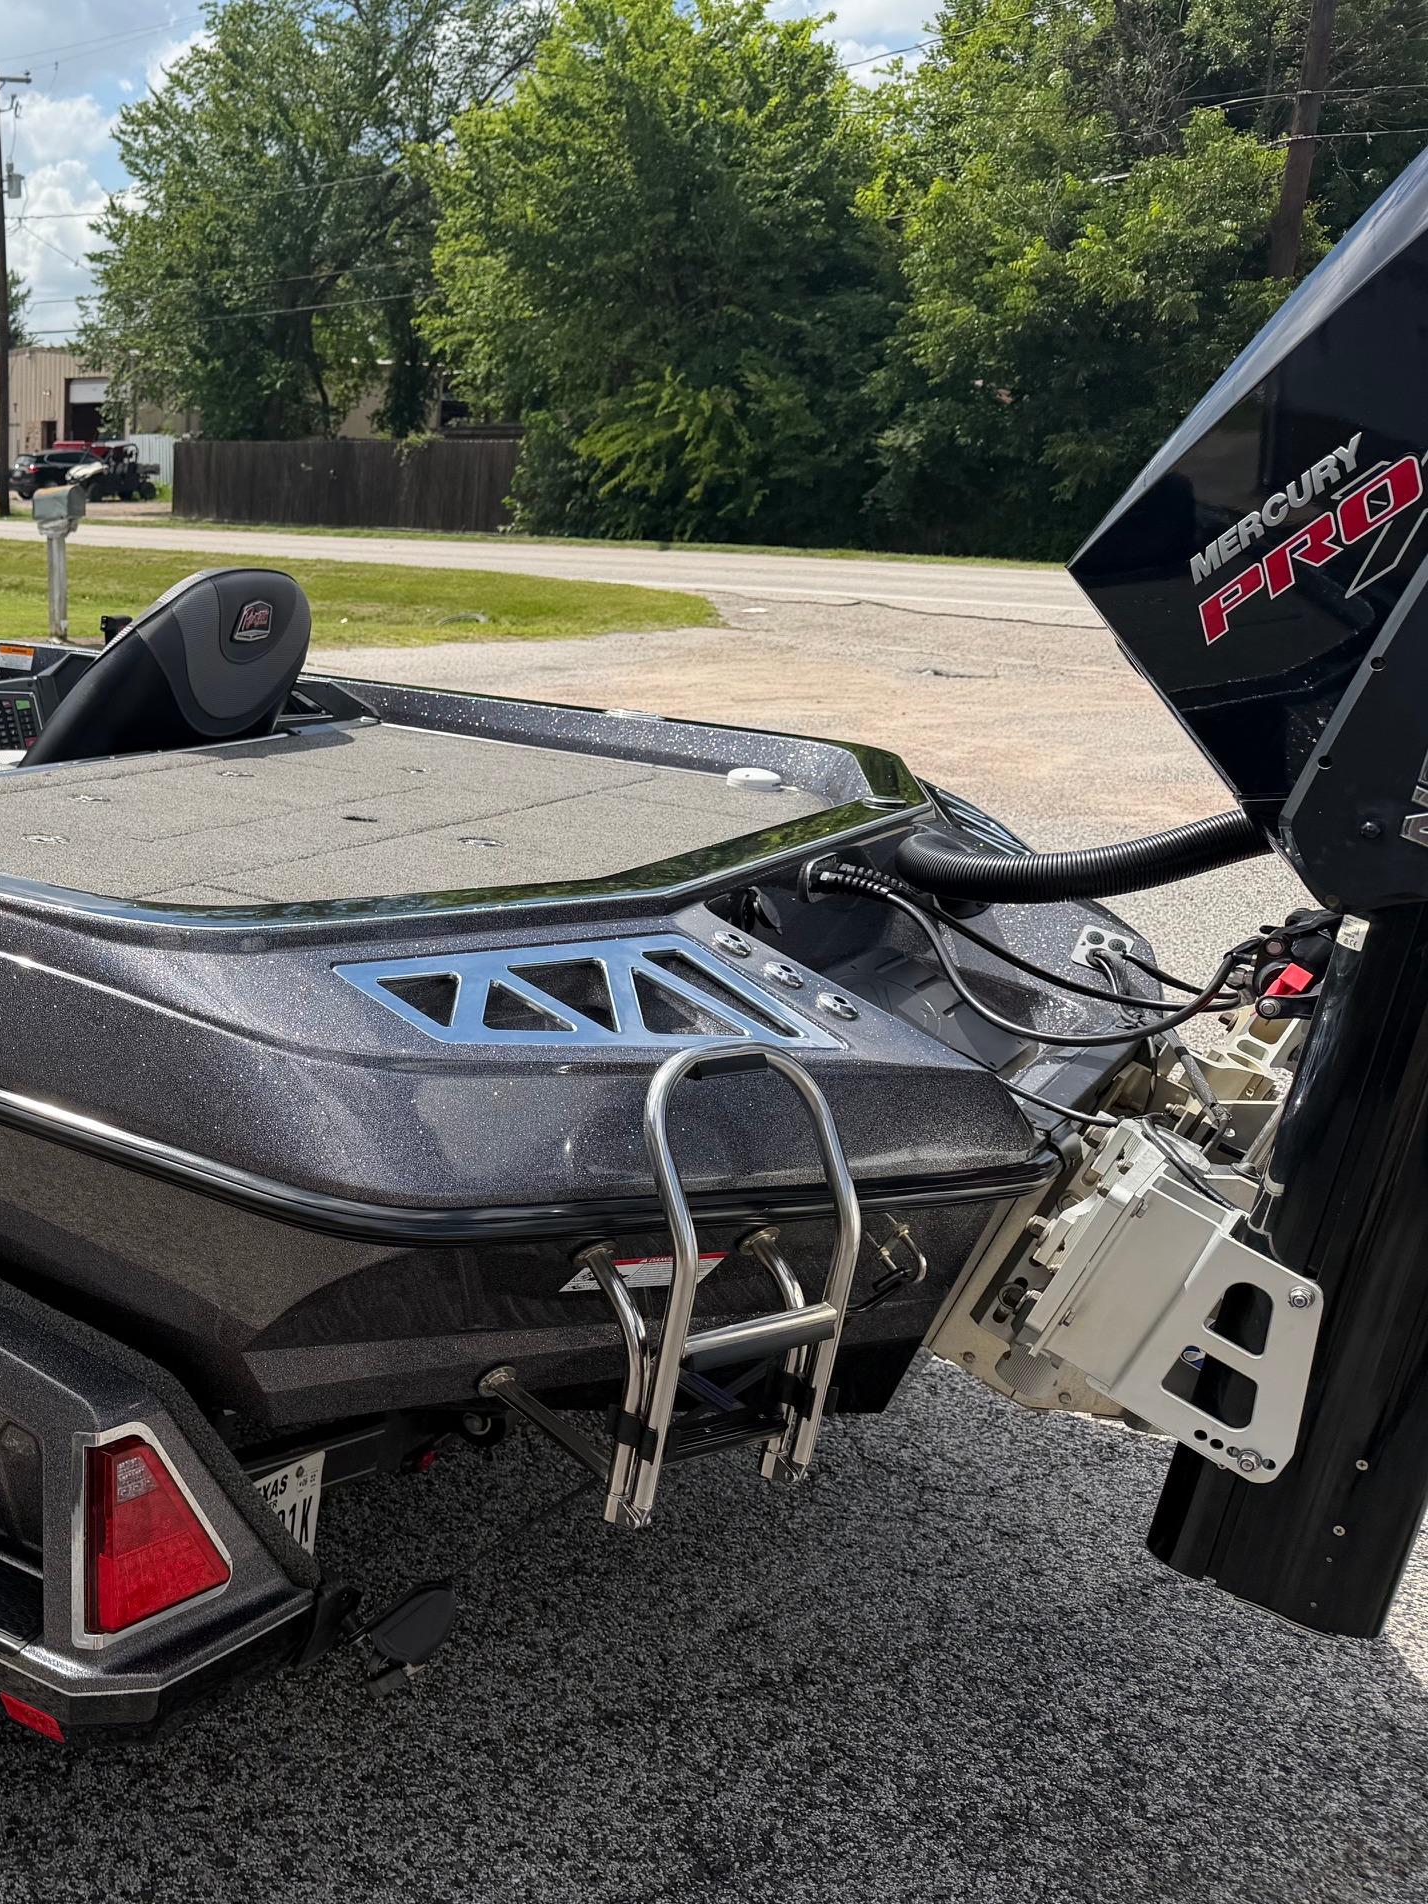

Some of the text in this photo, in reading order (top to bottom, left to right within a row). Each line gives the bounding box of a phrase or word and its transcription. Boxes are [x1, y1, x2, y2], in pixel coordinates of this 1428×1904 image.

[1189, 431, 1362, 586] MERCURY
[1198, 455, 1423, 646] PRO
[257, 1474, 289, 1501] XAS
